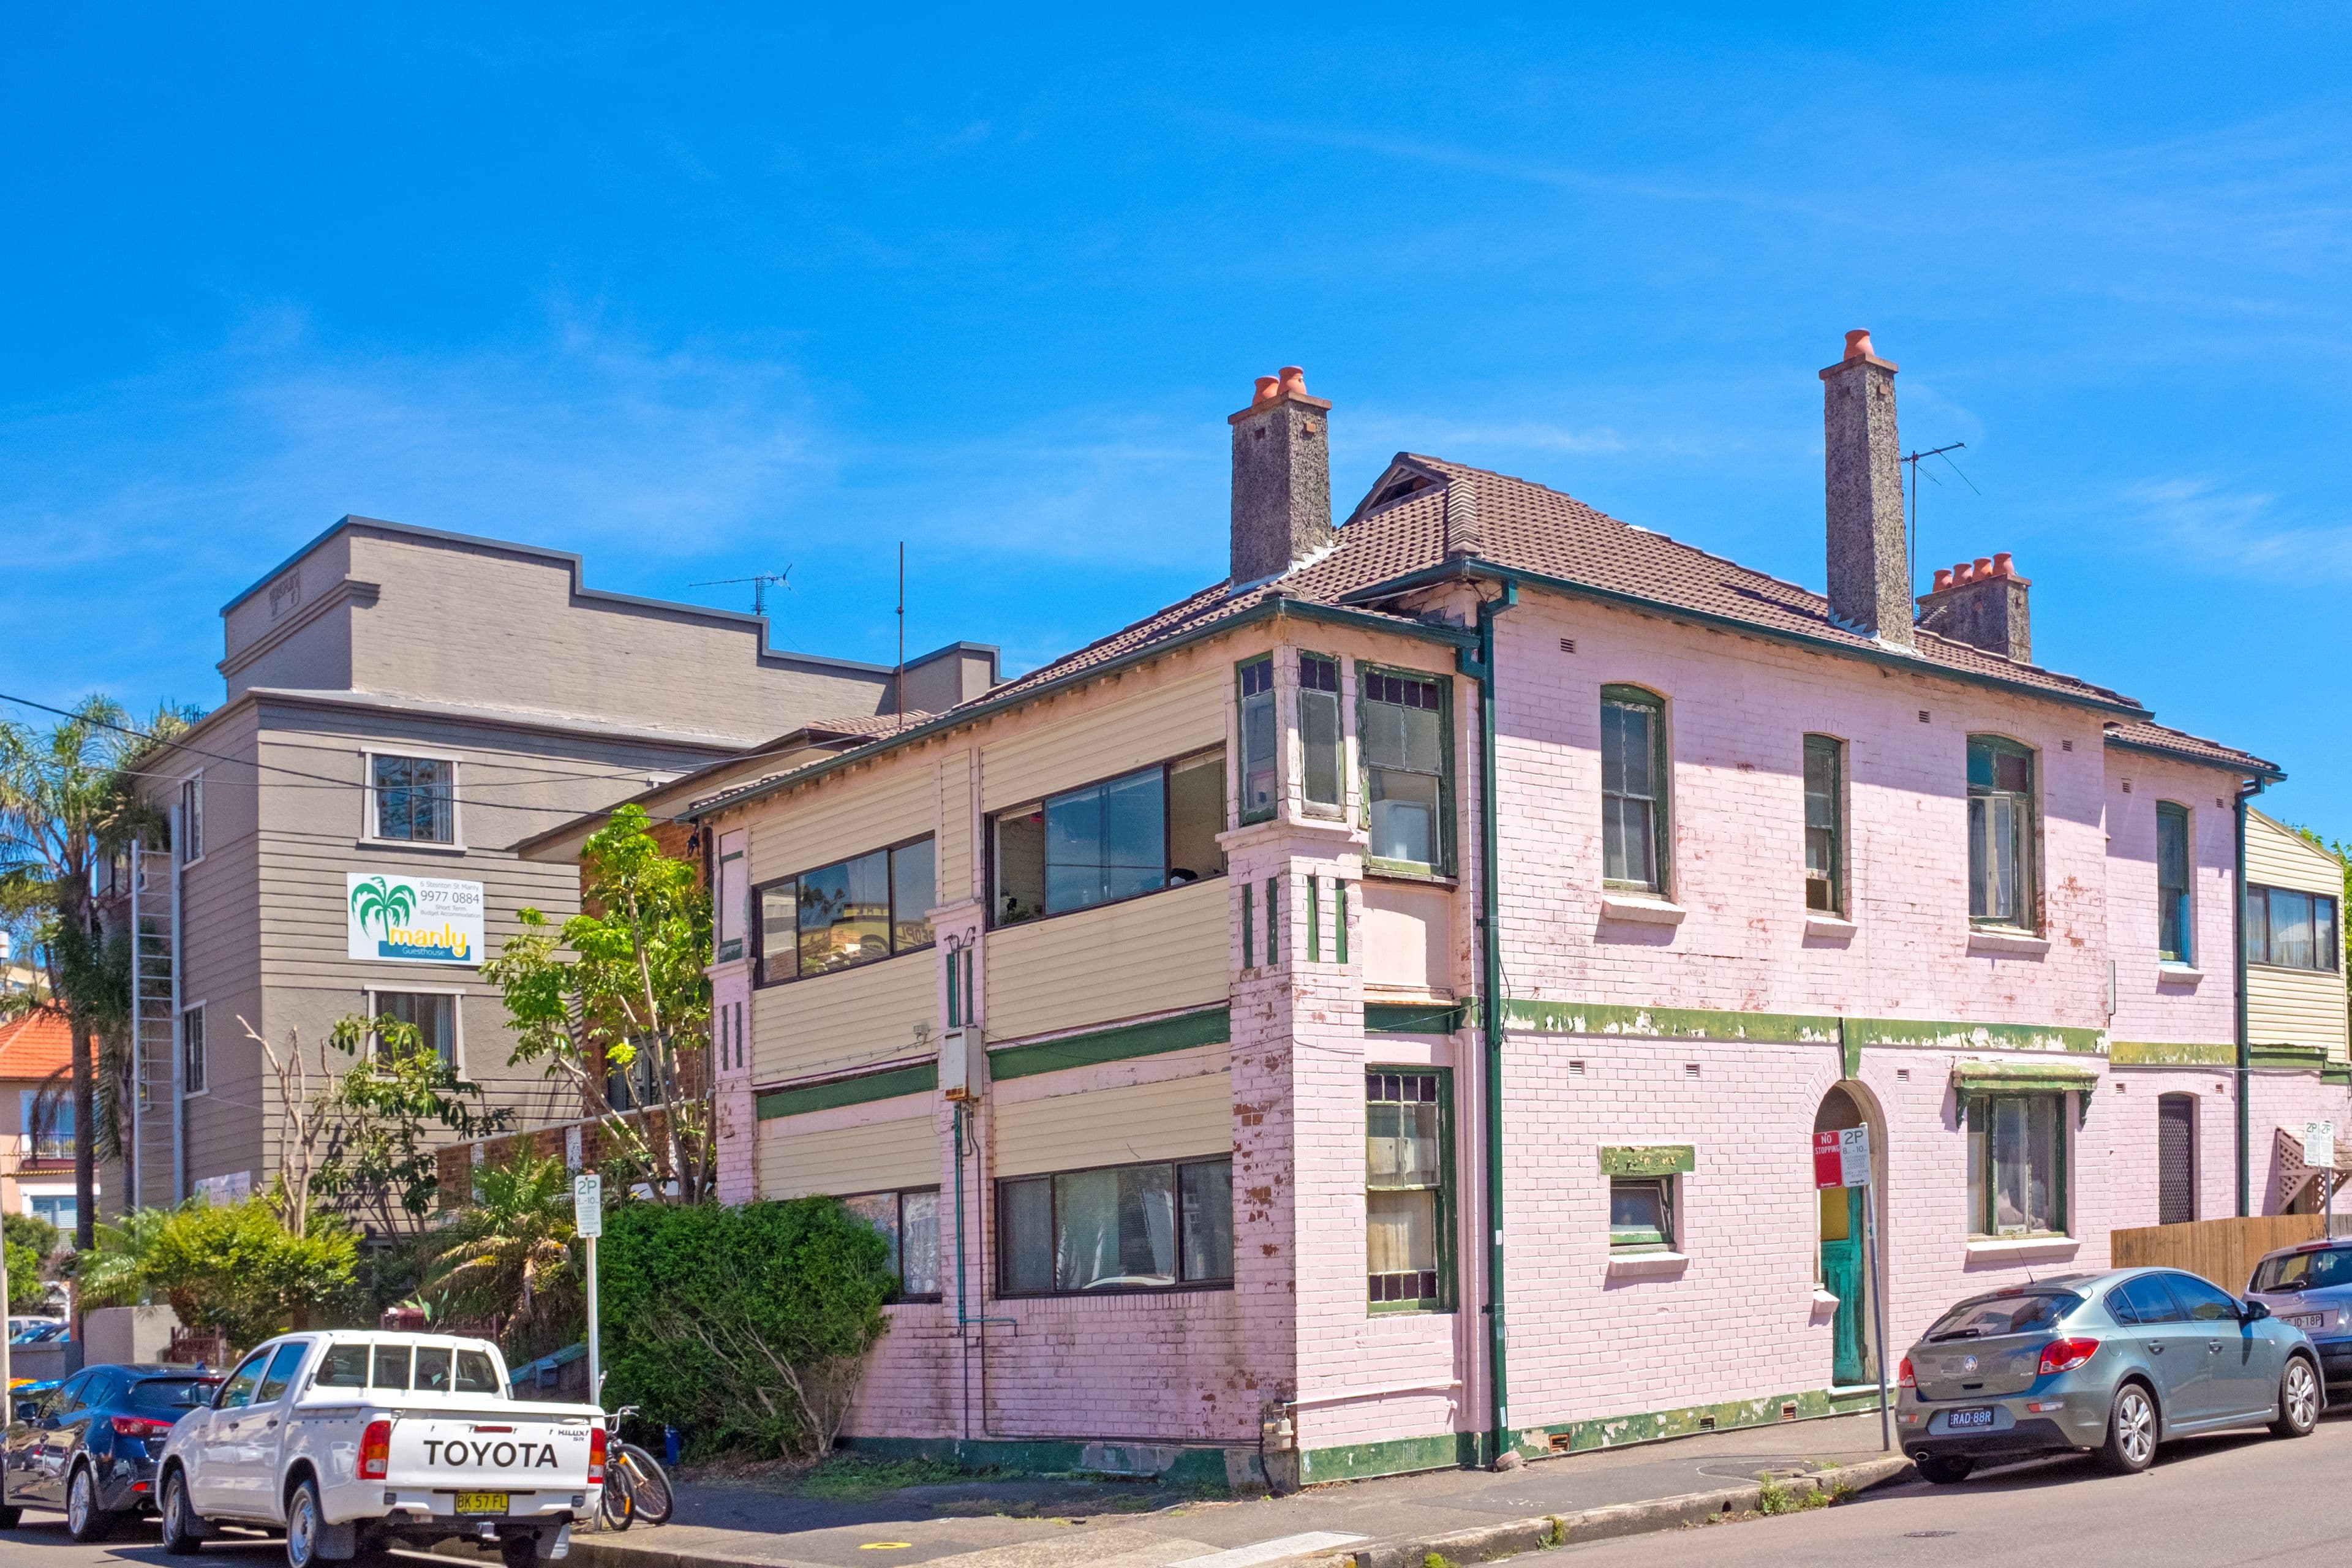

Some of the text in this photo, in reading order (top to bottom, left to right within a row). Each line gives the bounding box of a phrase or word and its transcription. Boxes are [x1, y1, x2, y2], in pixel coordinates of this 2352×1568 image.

[421, 890, 480, 904] 9977 0884
[389, 922, 466, 957] manly
[402, 947, 445, 956] Guesthouse
[2307, 1122, 2317, 1133] 2P
[1821, 1134, 1832, 1145] NO
[1844, 1130, 1863, 1145] 2P
[1815, 1145, 1840, 1155] STOPPING
[578, 1180, 597, 1194] 2P
[423, 1440, 559, 1468] TOYOTA
[457, 1494, 507, 1508] BK 57 FL
